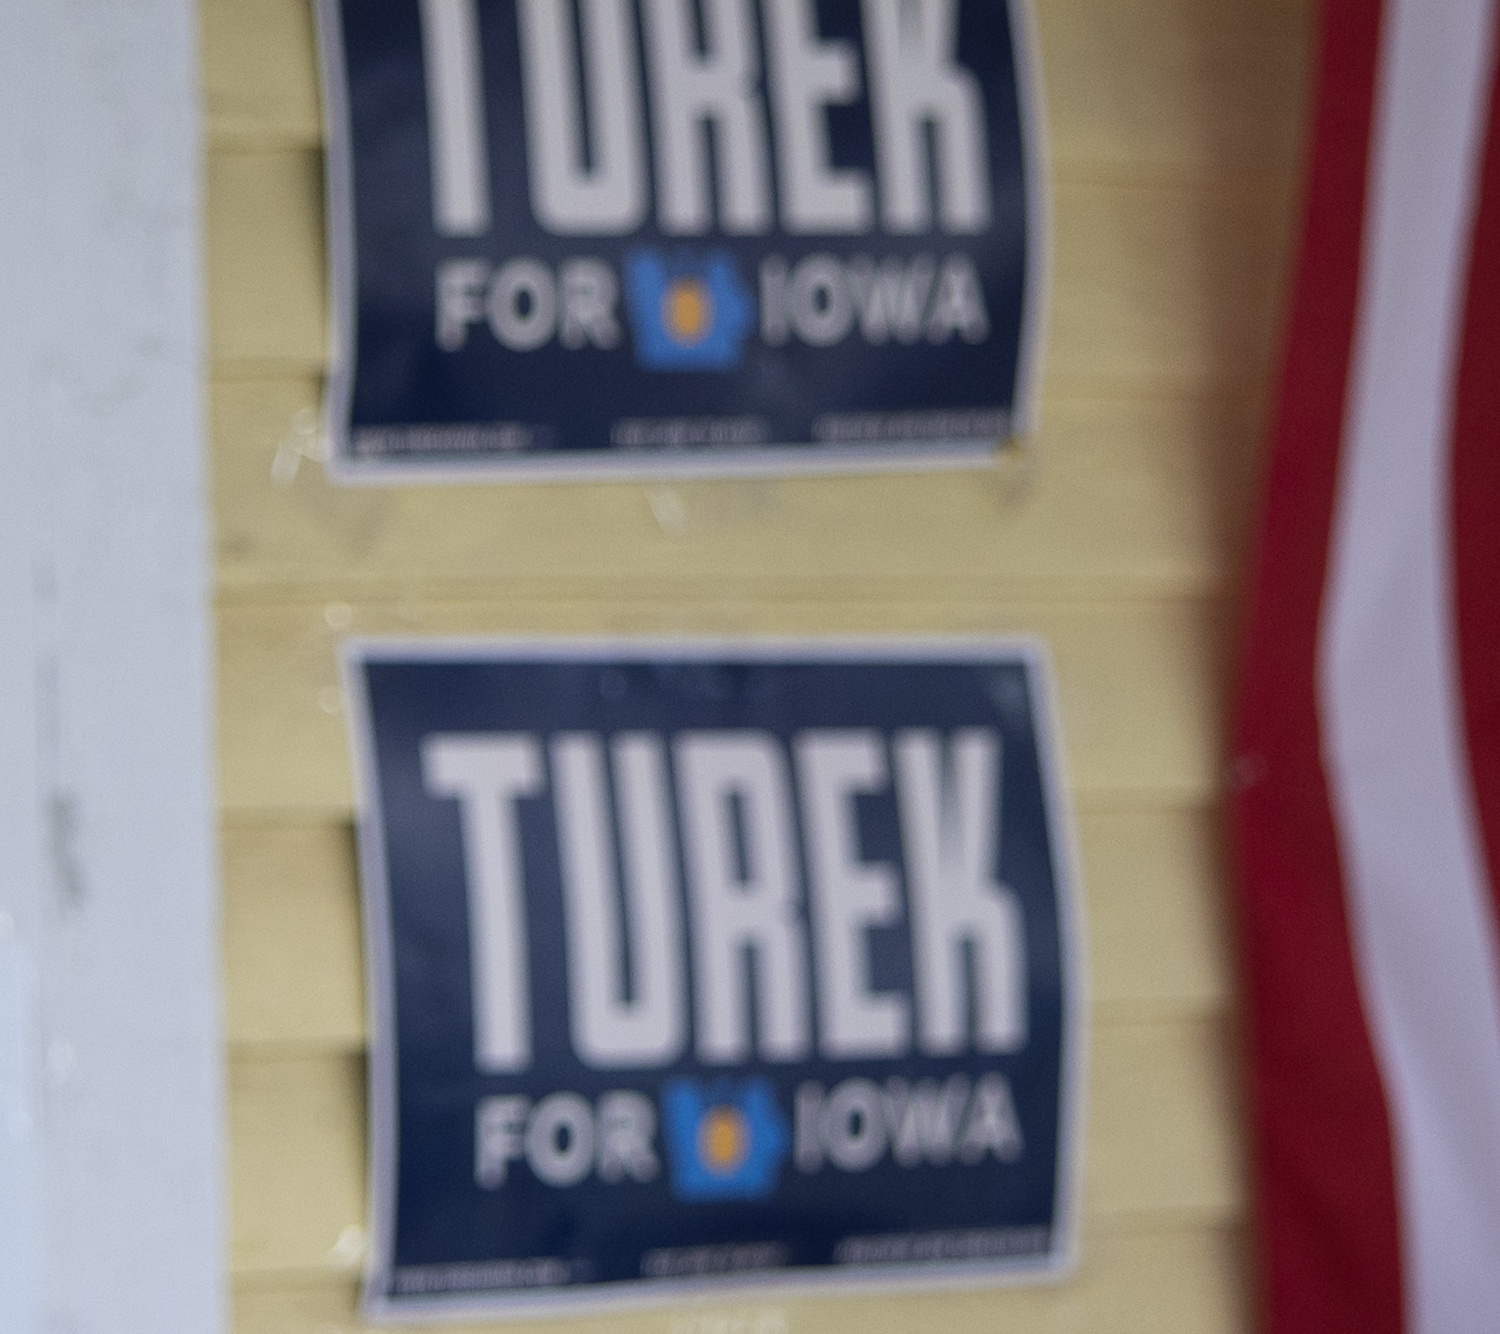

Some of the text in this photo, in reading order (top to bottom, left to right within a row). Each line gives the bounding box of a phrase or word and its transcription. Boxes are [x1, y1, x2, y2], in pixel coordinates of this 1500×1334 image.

[435, 252, 990, 352] FOR IOWA
[421, 727, 1027, 1073] TUREK
[474, 1072, 1024, 1189] FOR IOWA
